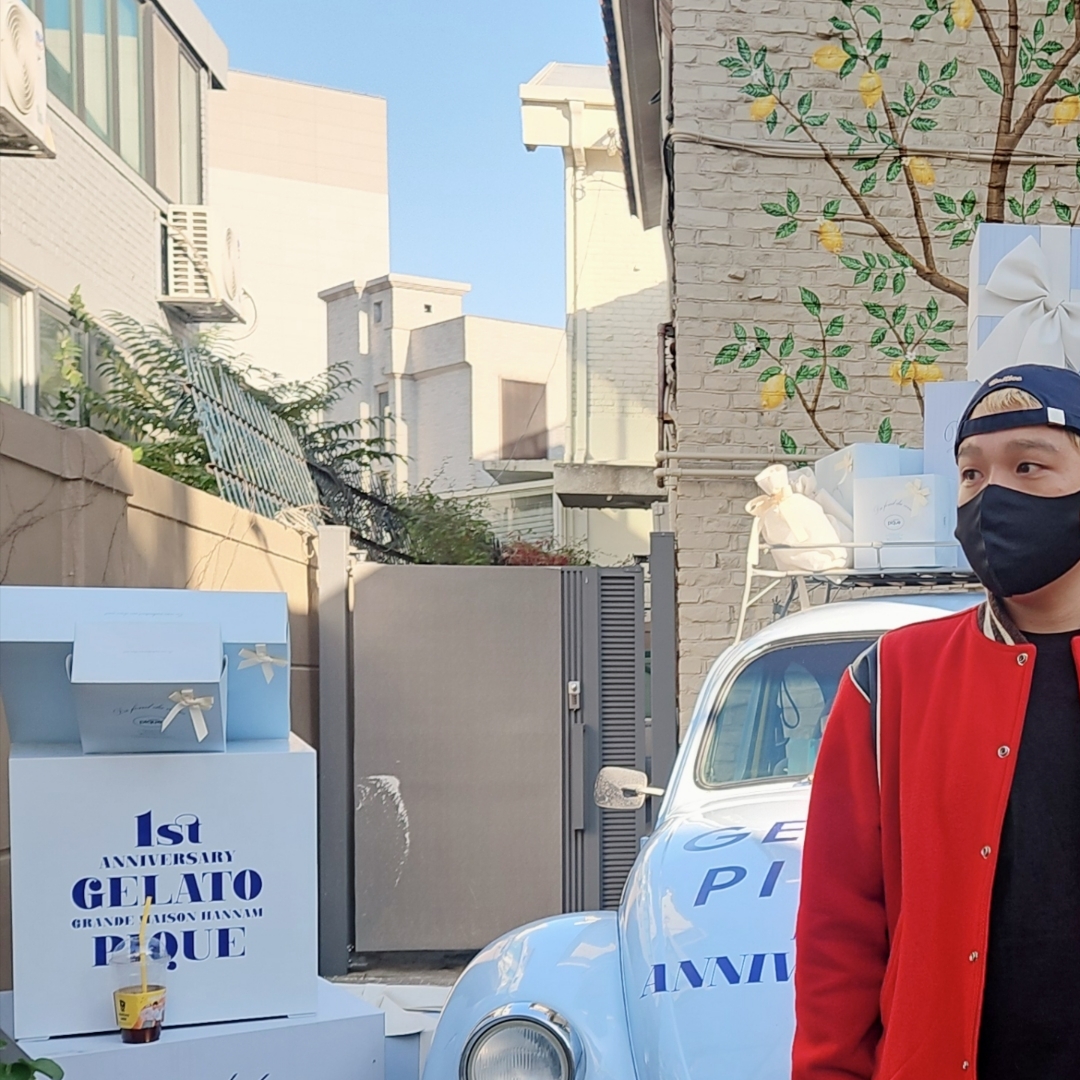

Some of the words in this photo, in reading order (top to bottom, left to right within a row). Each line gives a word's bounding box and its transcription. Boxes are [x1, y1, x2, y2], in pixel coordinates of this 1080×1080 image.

[134, 810, 203, 847] 1st
[683, 820, 806, 852] GE
[100, 850, 236, 869] ANNIVERSARY
[72, 869, 263, 910] GELATO
[693, 860, 786, 907] PI
[71, 915, 135, 930] GRANDE
[201, 907, 264, 921] HANNAM
[640, 952, 796, 999] ANNIV
